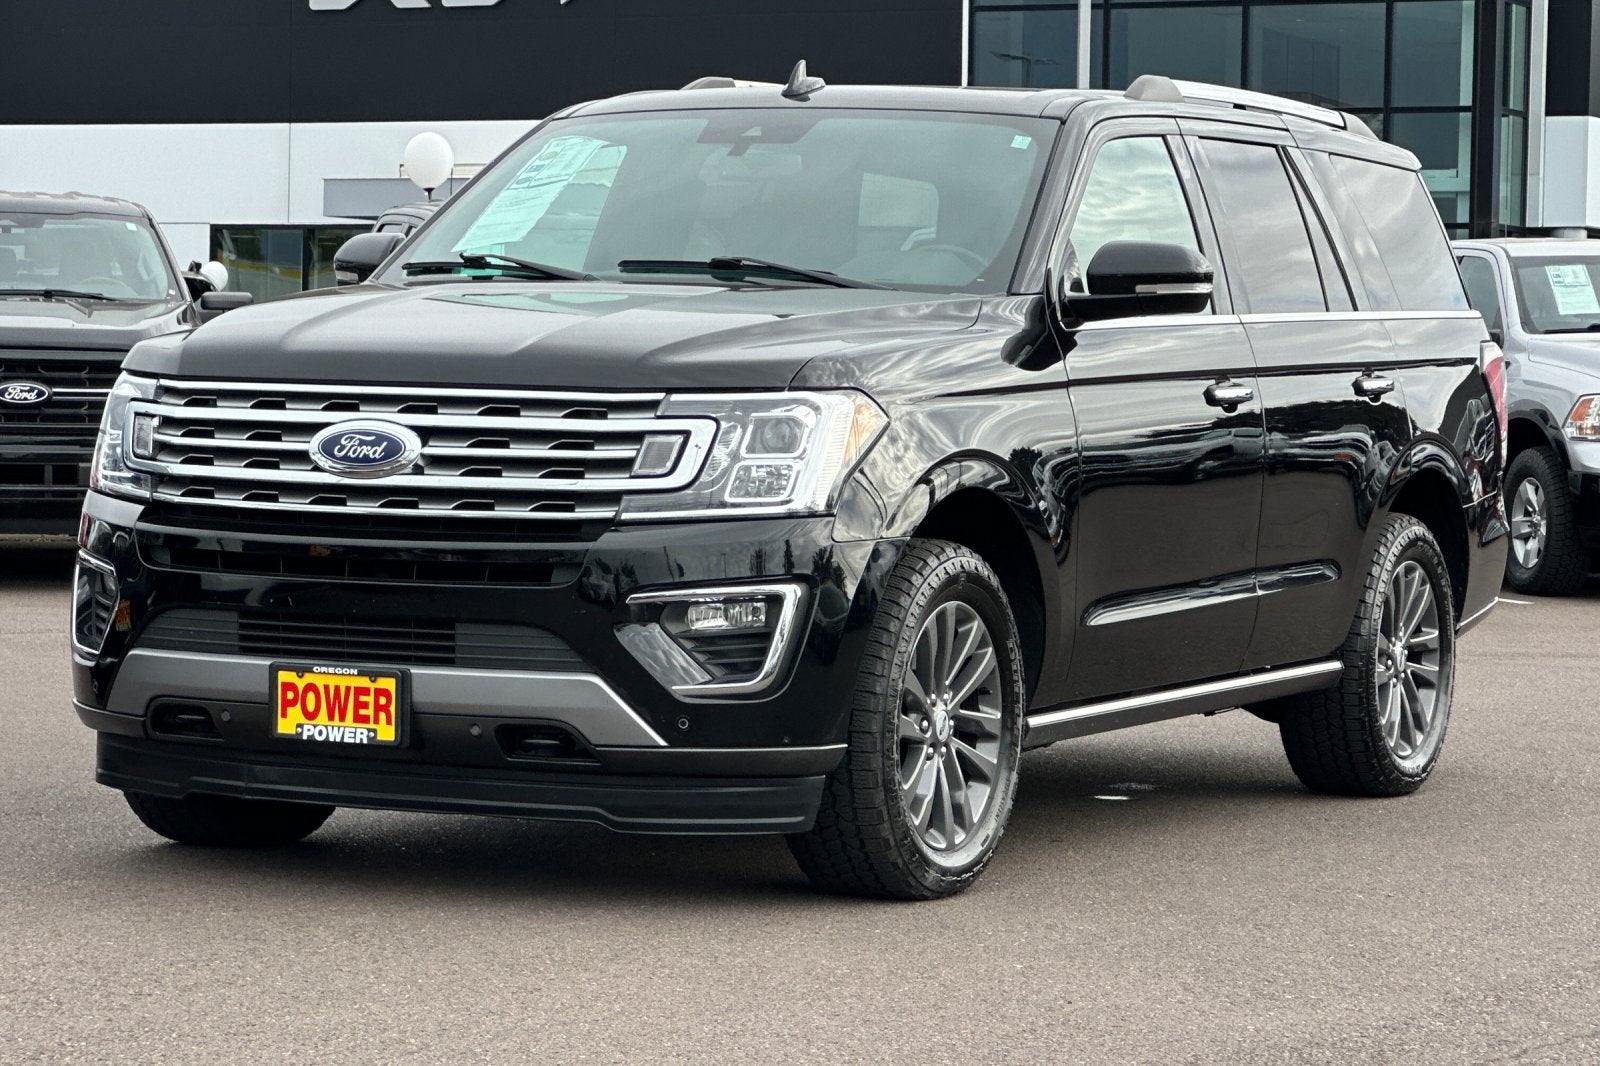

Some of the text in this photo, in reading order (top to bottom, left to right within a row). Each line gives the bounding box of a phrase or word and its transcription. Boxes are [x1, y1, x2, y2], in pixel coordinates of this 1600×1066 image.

[4, 386, 38, 400] Ford
[333, 433, 388, 459] Ford
[313, 666, 358, 675] OREGON
[280, 681, 393, 726] POWER
[302, 724, 368, 744] POWER
